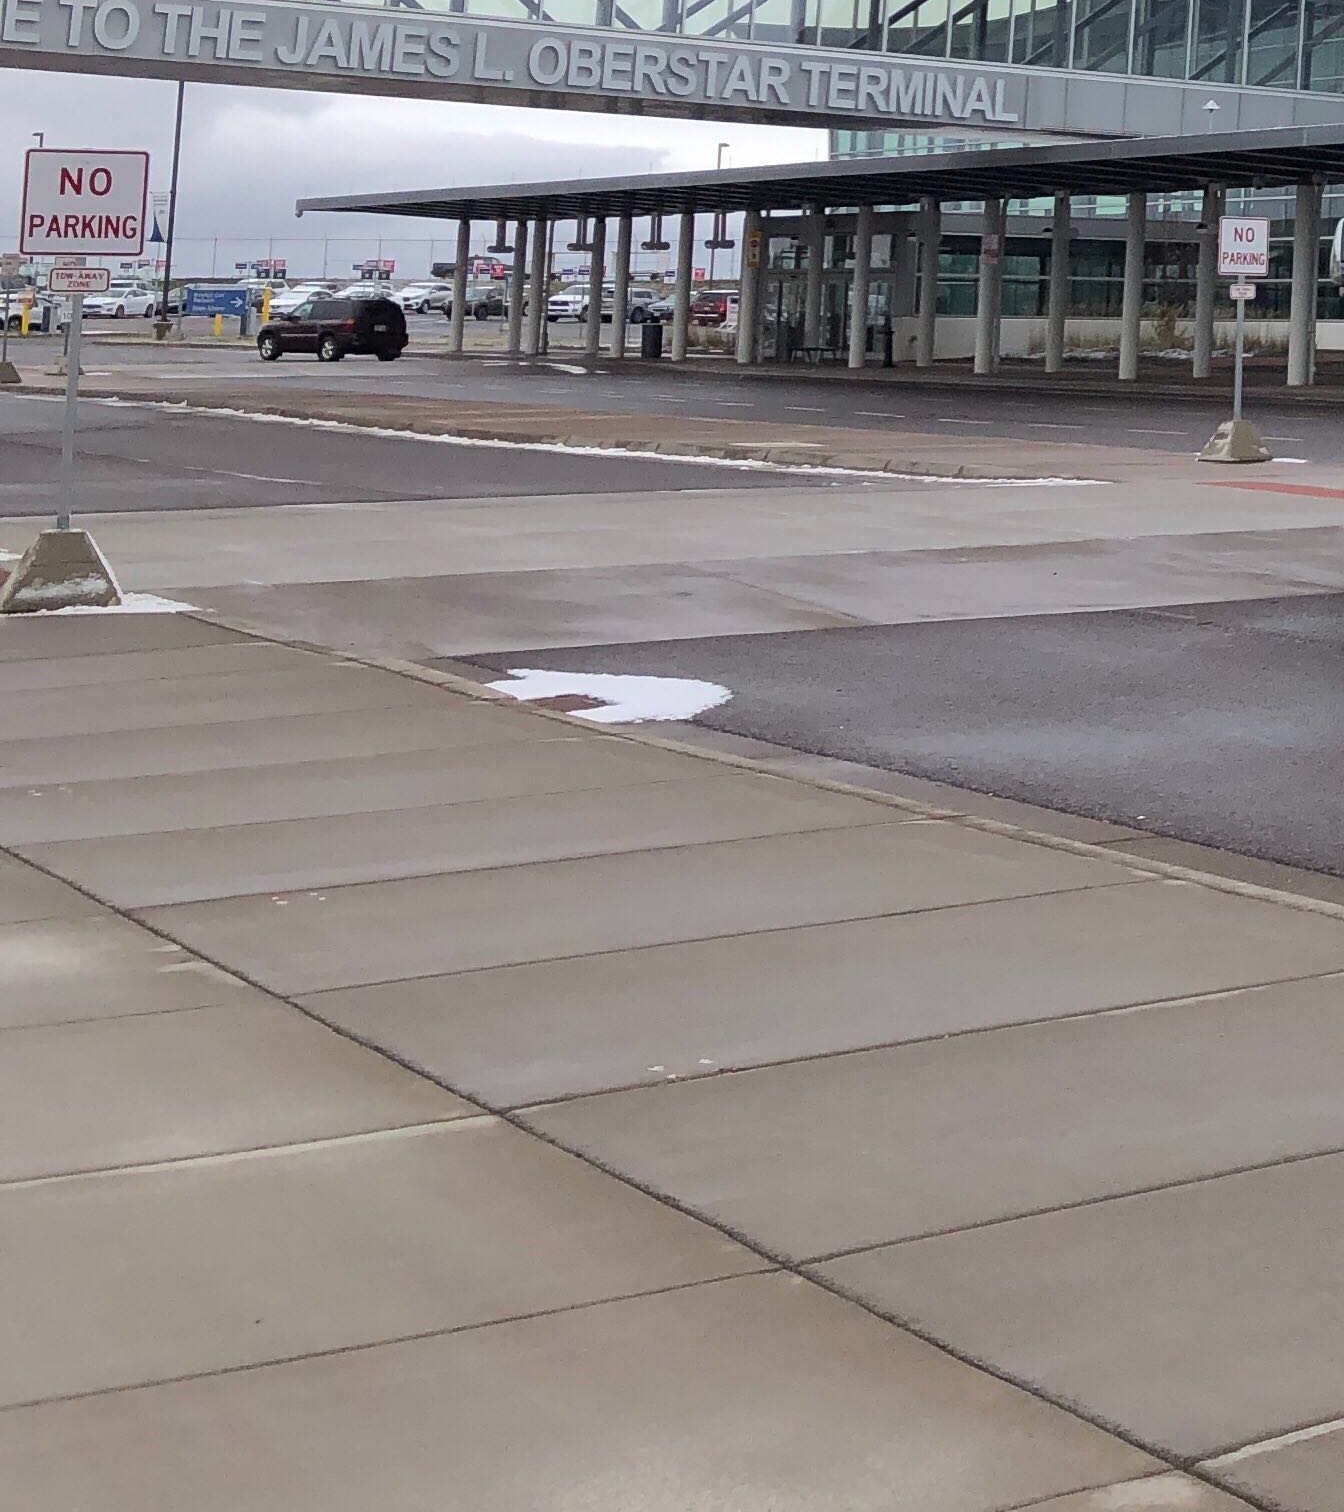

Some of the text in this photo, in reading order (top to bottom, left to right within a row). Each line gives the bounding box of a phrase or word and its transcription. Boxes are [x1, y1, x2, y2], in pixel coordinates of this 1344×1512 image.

[153, 3, 267, 62] THE
[276, 16, 460, 77] JAMES
[473, 31, 514, 82] L.
[527, 37, 791, 104] OBERSTAR
[800, 59, 1018, 122] TERMINAL
[59, 167, 113, 196] NO
[28, 214, 137, 239] PARKING
[1233, 227, 1255, 243] NO
[1222, 252, 1265, 266] PARKING
[55, 272, 105, 280] TOW-AWAY
[67, 280, 91, 288] ZONE
